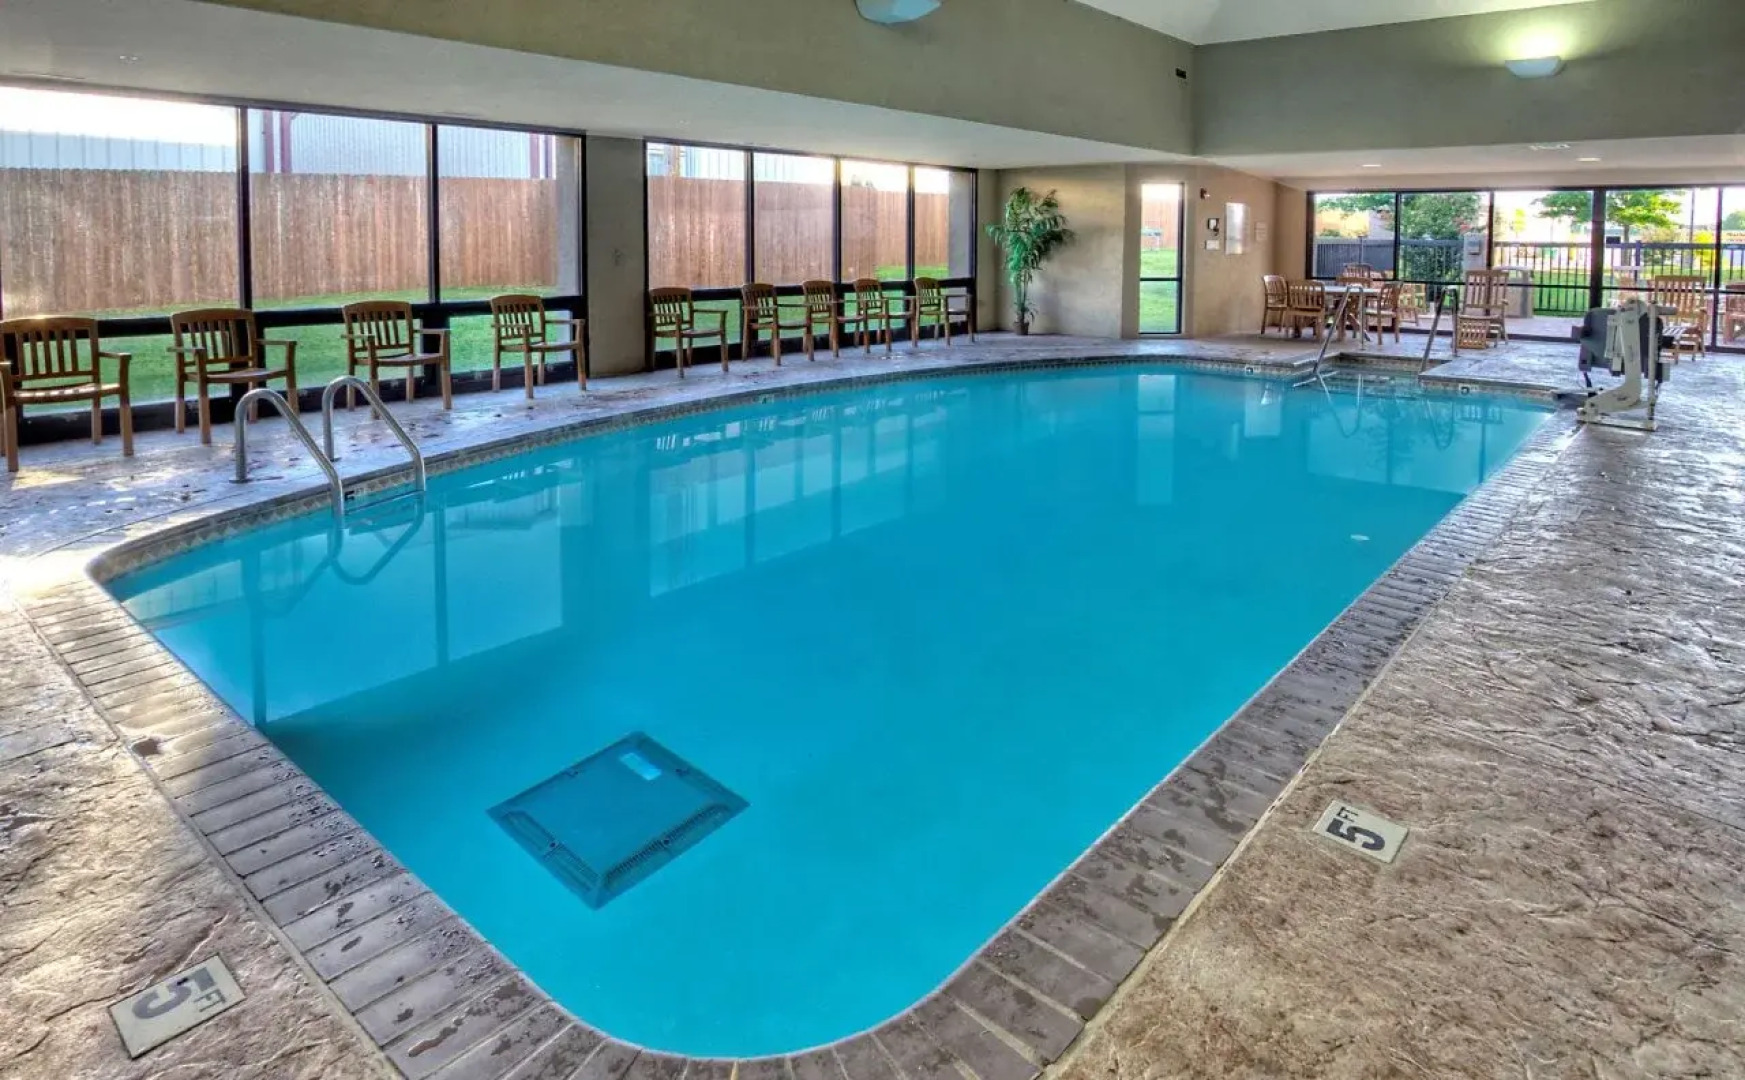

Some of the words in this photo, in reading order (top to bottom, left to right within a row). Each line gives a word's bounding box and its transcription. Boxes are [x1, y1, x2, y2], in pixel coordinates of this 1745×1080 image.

[1336, 806, 1359, 822] FT
[1326, 818, 1385, 851] 5
[132, 966, 216, 1019] 5
[193, 988, 227, 1012] FT
